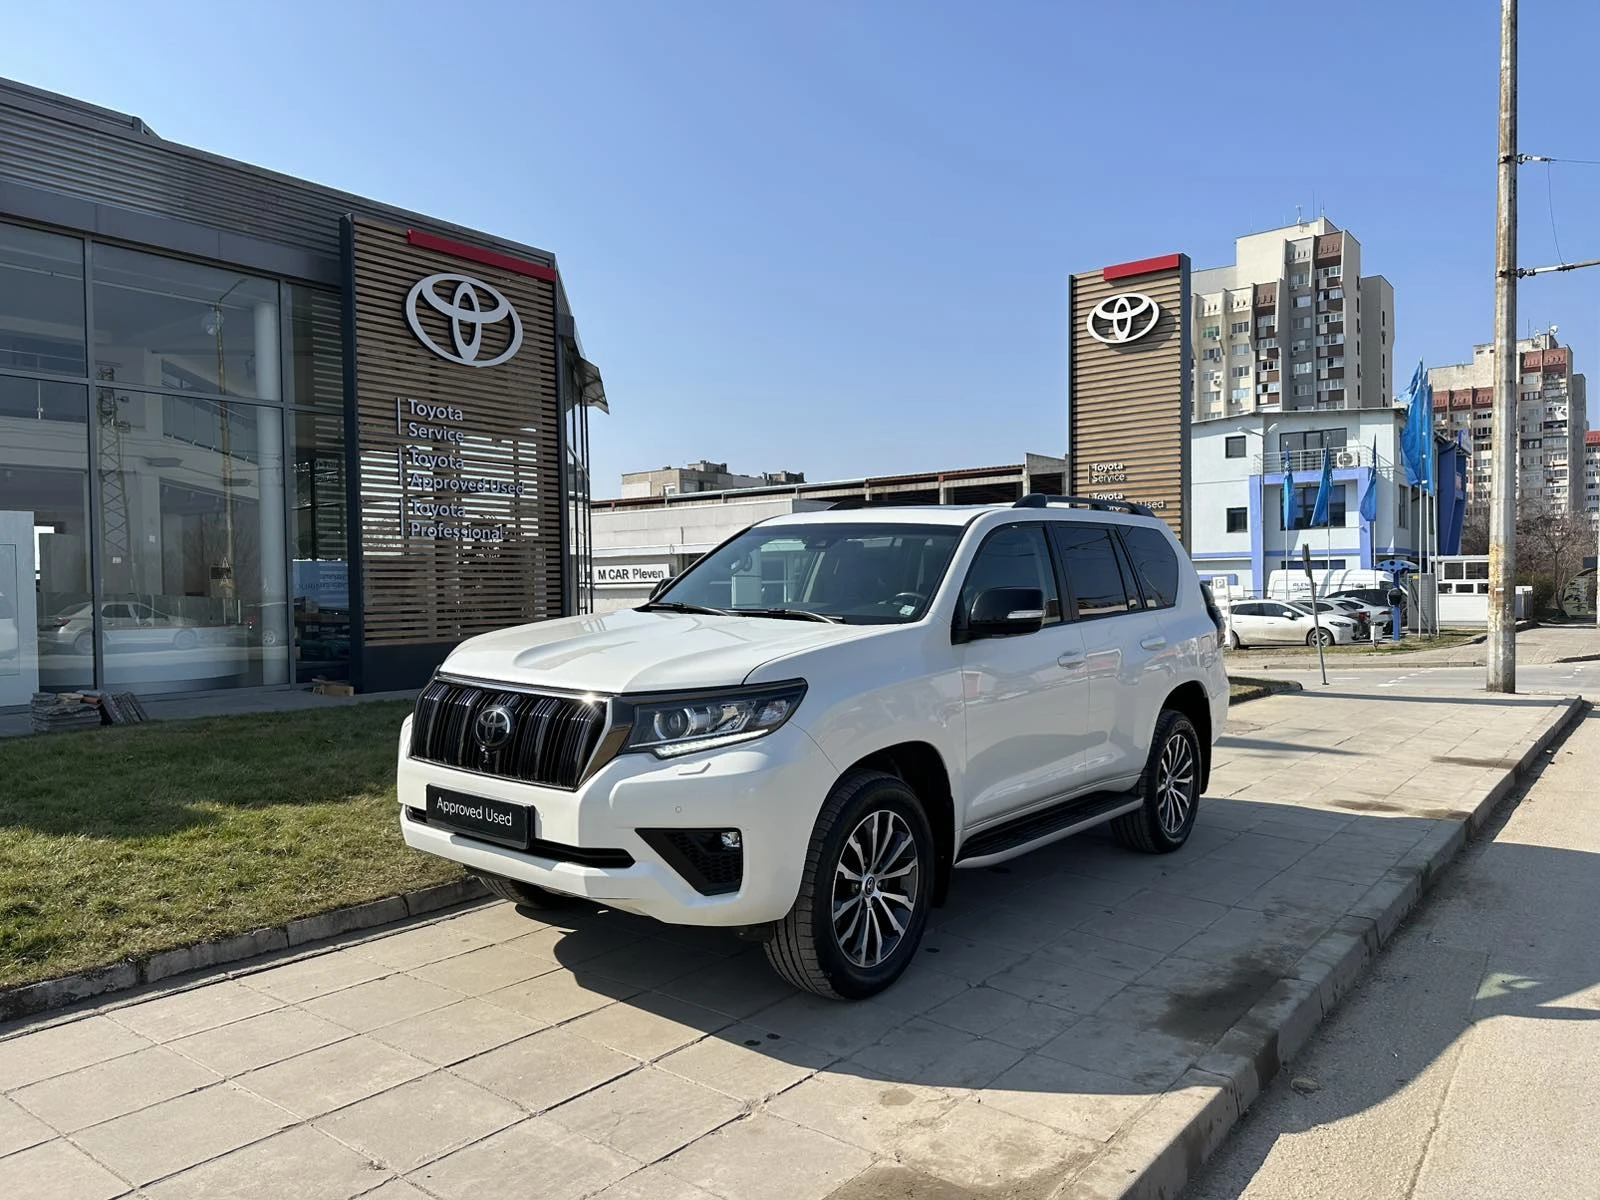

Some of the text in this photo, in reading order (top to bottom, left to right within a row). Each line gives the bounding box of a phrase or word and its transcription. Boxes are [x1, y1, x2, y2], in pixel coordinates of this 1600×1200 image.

[408, 398, 463, 421] Toyota
[408, 423, 464, 442] Service
[409, 448, 465, 470] Toyota
[1092, 463, 1123, 472] Toyota
[410, 472, 525, 495] Approved Used
[1092, 473, 1125, 483] Service
[411, 500, 466, 519] Toyota
[411, 522, 504, 540] Professional
[598, 568, 664, 580] M CAR Pleven
[437, 796, 512, 826] Approved Used
